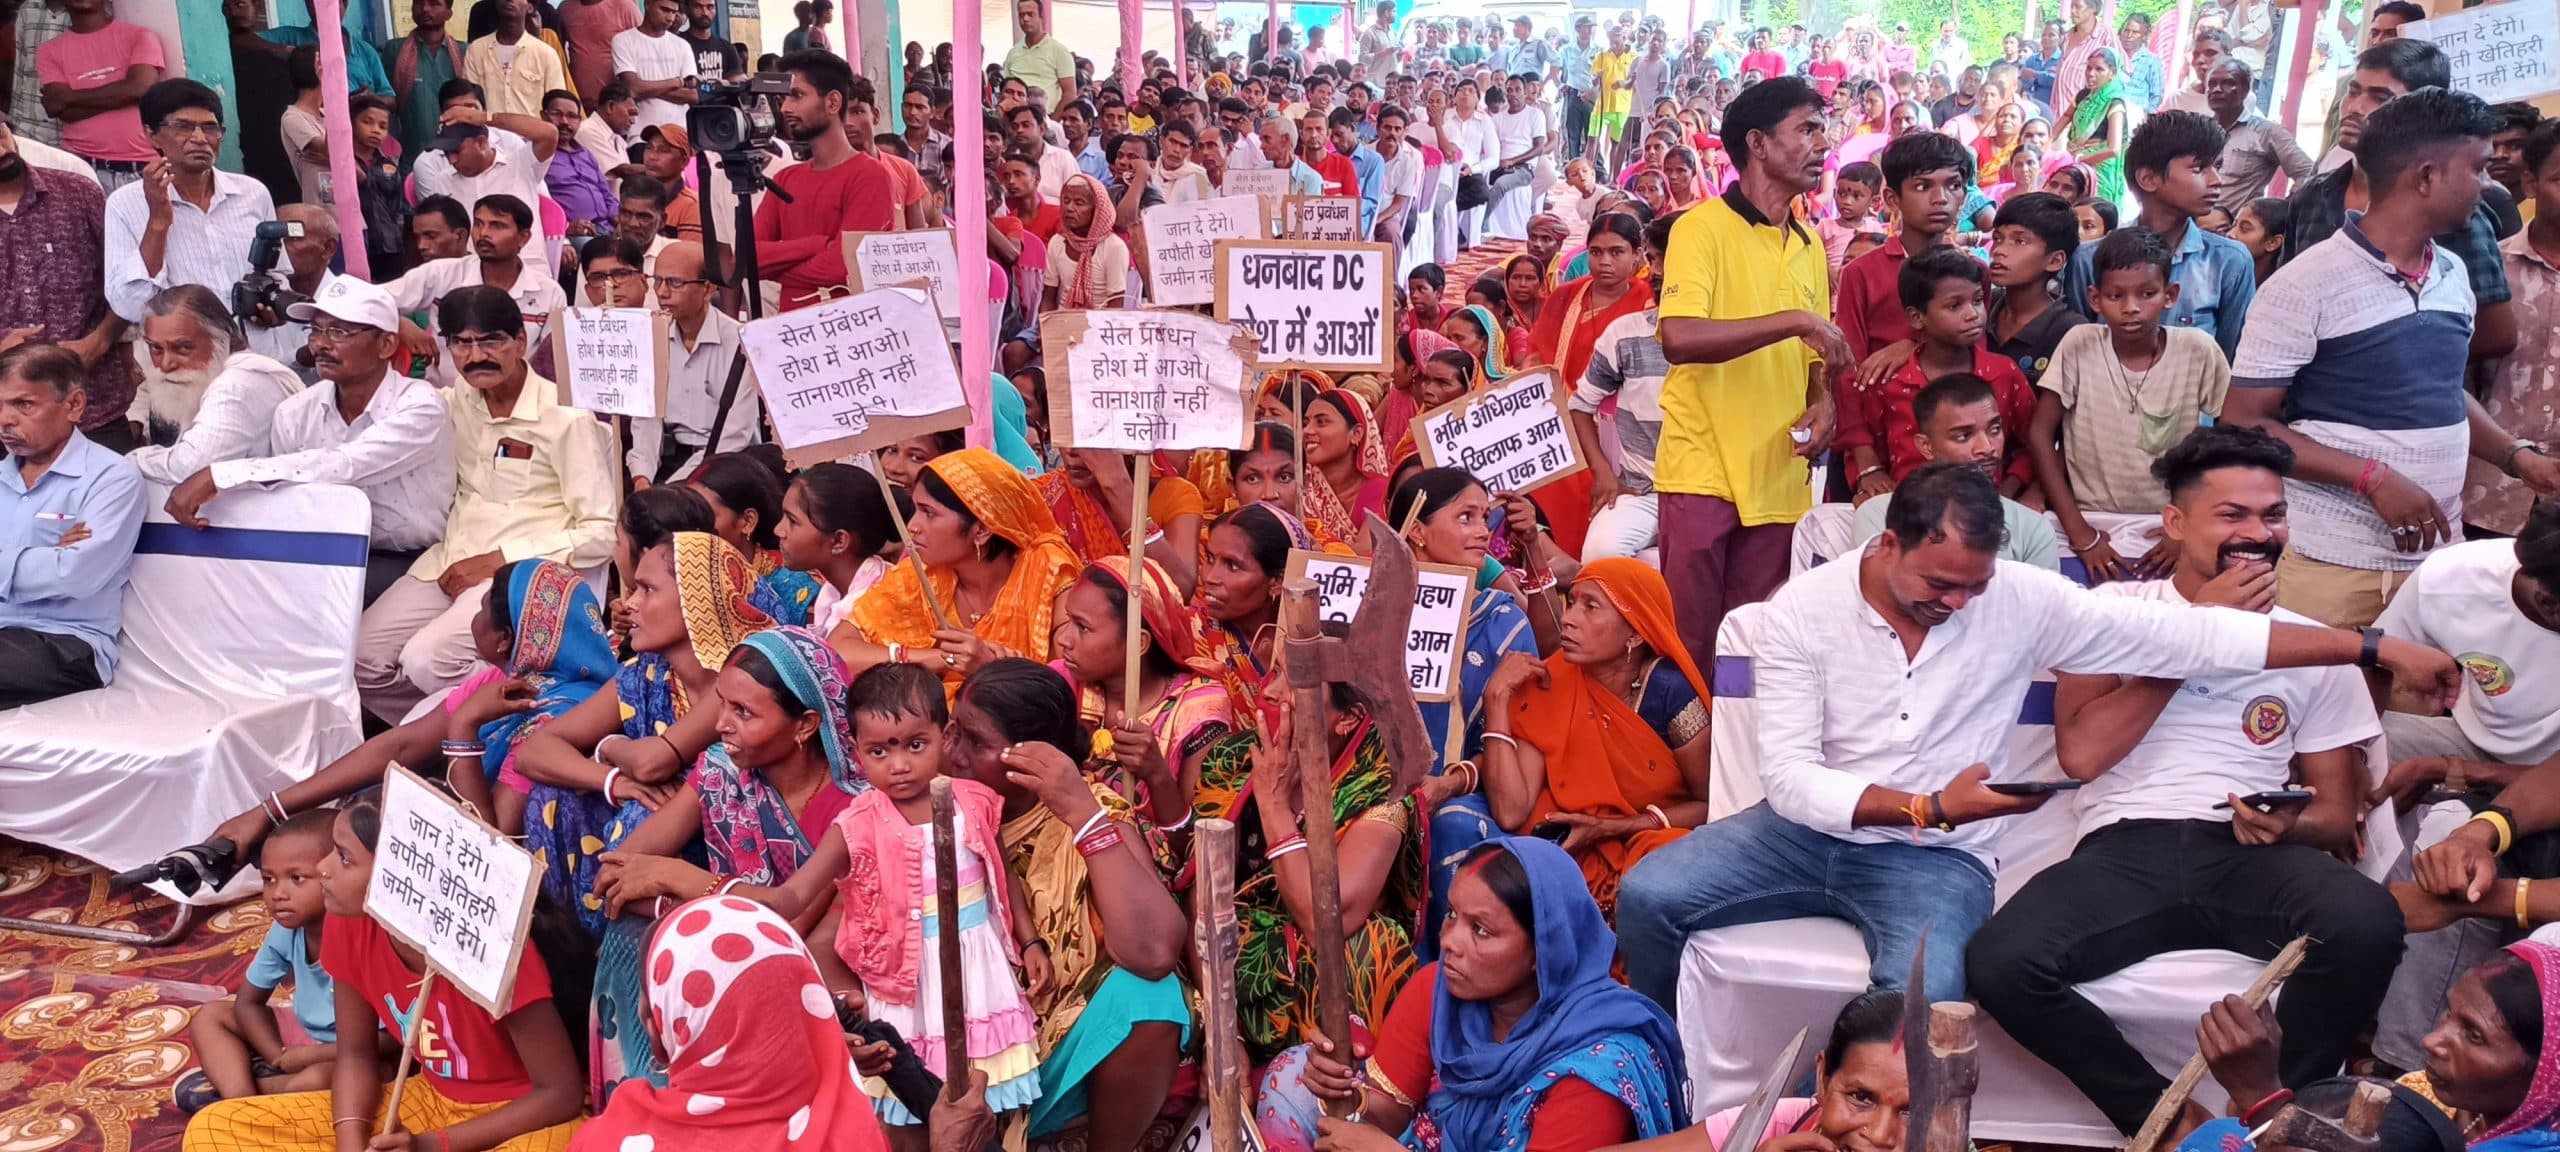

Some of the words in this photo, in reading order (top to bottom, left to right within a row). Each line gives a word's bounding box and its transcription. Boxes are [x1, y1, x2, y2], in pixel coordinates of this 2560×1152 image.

[2432, 31, 2468, 49] जान
[2473, 23, 2485, 41] दे
[2477, 34, 2544, 63] खेतिहरी
[2476, 64, 2508, 87] नहीं
[1164, 222, 1191, 237] जान
[1194, 215, 1204, 234] दे
[872, 241, 889, 256] सेल
[872, 260, 890, 278] होश
[893, 259, 902, 275] में
[1159, 266, 1196, 288] जमीन
[1333, 253, 1364, 291] DC
[580, 315, 595, 333] सेल
[778, 324, 817, 348] सेल
[820, 305, 883, 338] प्रबंधन
[1099, 320, 1132, 346] सेल
[1285, 305, 1312, 355] में
[1313, 306, 1380, 357] आओं
[577, 339, 594, 360] होश
[778, 355, 820, 383] होश
[824, 345, 842, 368] में
[847, 327, 910, 362] आओ।
[620, 364, 638, 385] नहीं
[1091, 353, 1127, 380] होश
[1133, 352, 1149, 377] में
[1155, 354, 1210, 380] आओ।
[787, 368, 877, 409] तानाशाही
[880, 354, 917, 384] नहीं
[1091, 384, 1168, 412] तानाशाही
[1173, 386, 1210, 414] नहीं
[1433, 412, 1468, 451] भूमि
[1471, 382, 1546, 428] अधिग्रहण
[1460, 432, 1522, 473] खिलाफ
[1526, 416, 1561, 446] आम
[1507, 458, 1536, 486] एक
[1538, 443, 1567, 471] हो।
[1313, 566, 1358, 607] भूमि
[1408, 630, 1453, 653] आम
[1410, 658, 1442, 688] हो।
[409, 810, 442, 848] जान
[445, 829, 455, 860] दे
[457, 839, 490, 883] देंगे।
[390, 835, 435, 883] बपौती
[439, 868, 497, 926] खेतिहरी
[382, 868, 426, 914] जमीन
[456, 918, 487, 963] देंगे।
